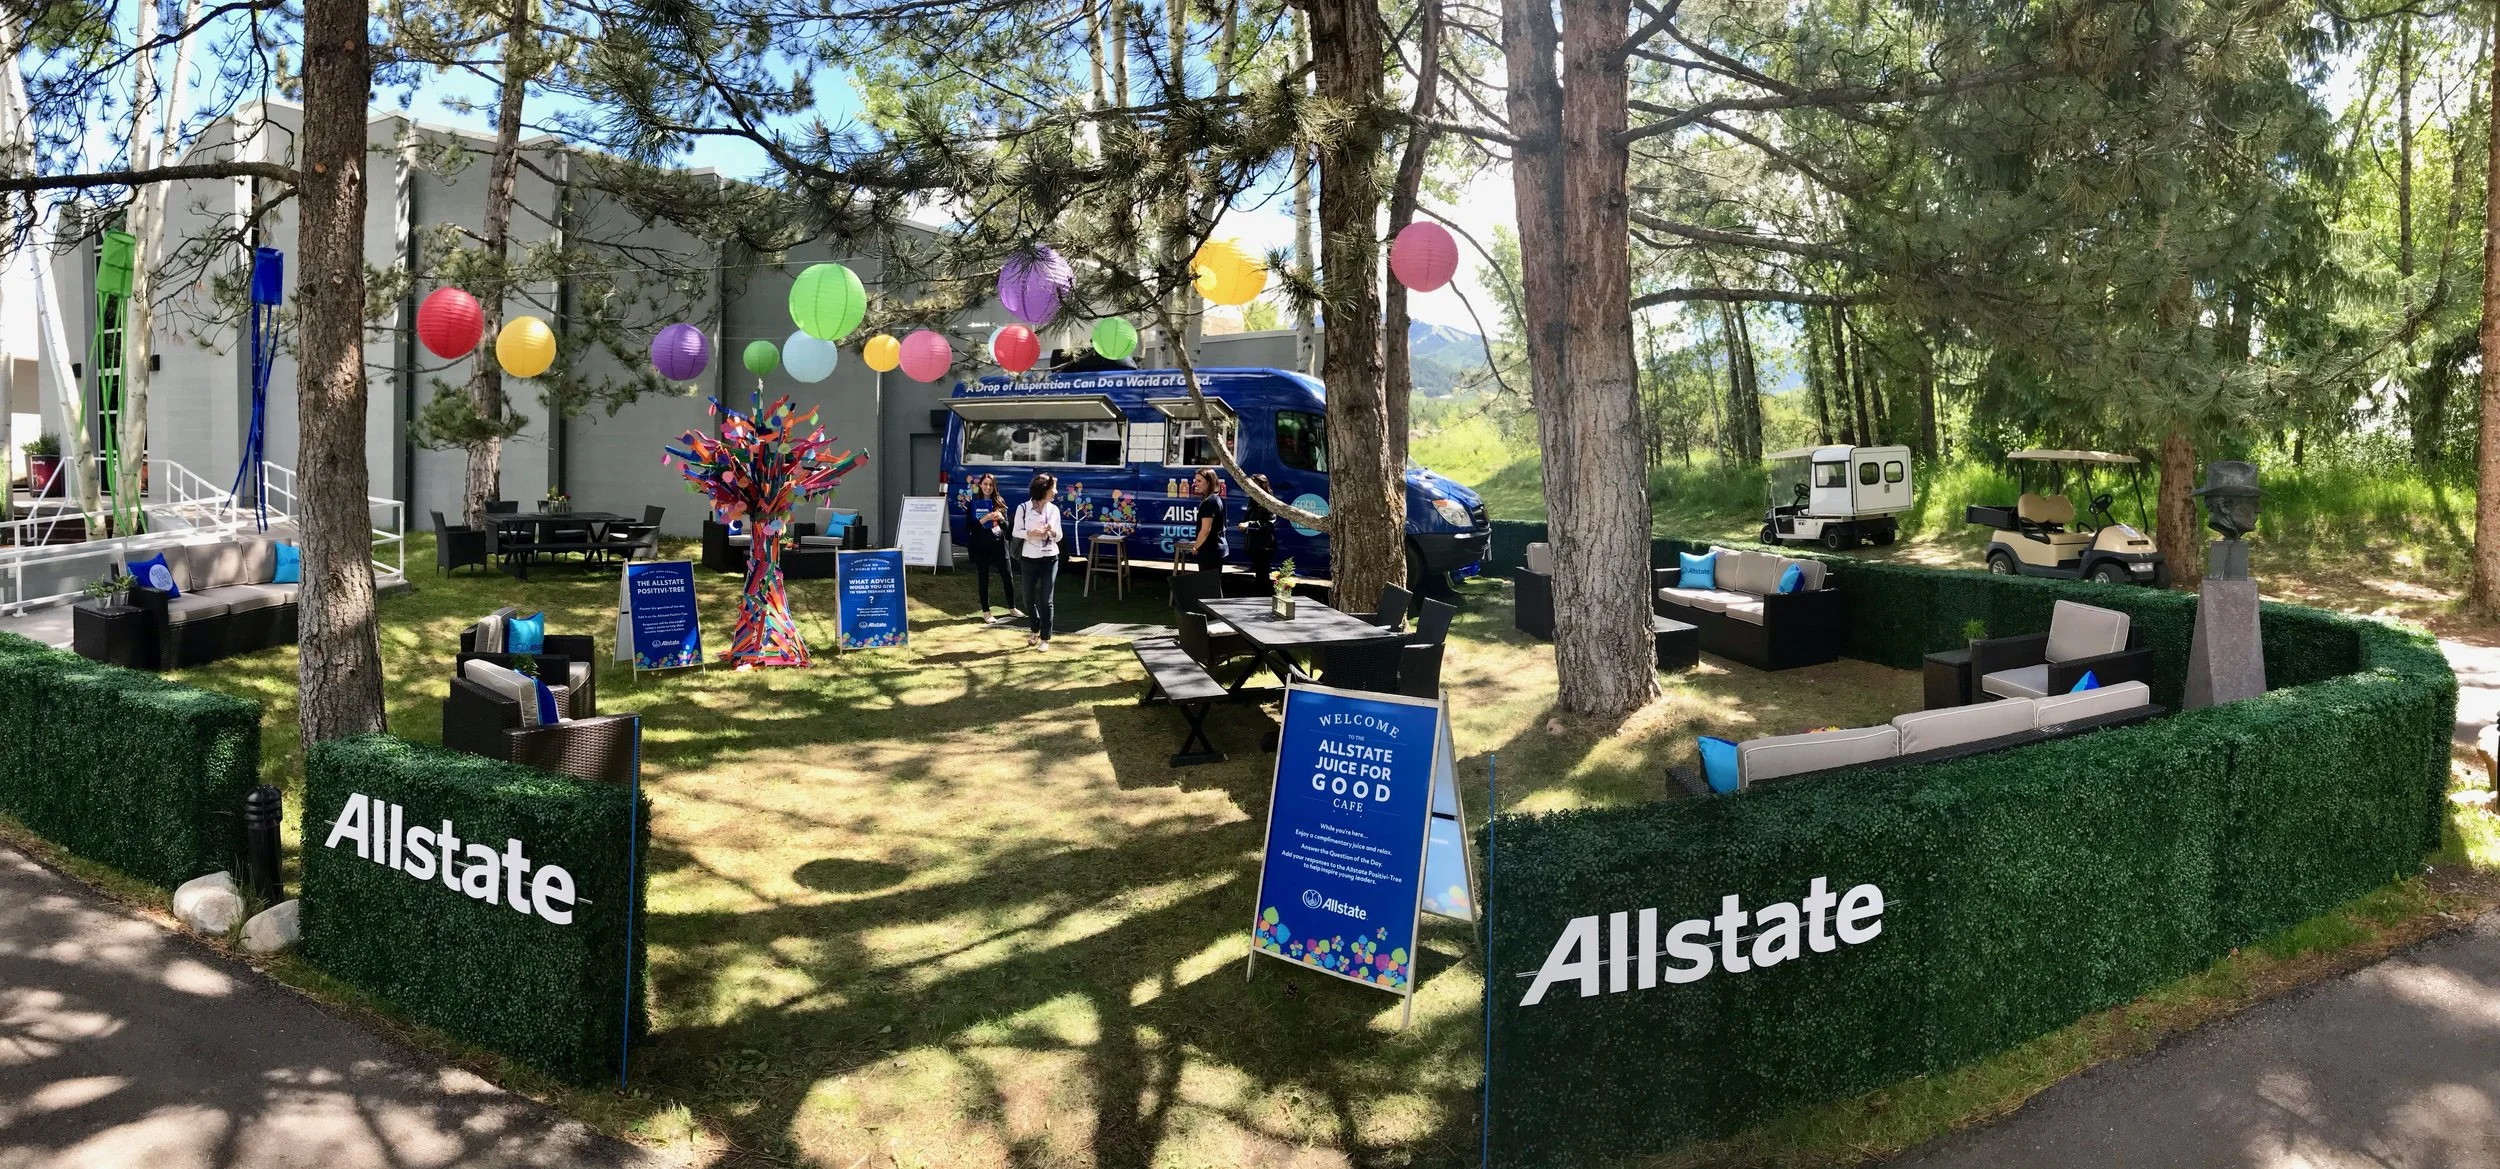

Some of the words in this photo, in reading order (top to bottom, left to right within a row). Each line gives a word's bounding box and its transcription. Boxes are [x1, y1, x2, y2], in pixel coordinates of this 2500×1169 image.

[976, 382, 1000, 394] Drop
[1002, 381, 1014, 391] of
[1014, 380, 1071, 393] Inspiration
[1073, 379, 1095, 389] Can
[1098, 378, 1114, 388] Do
[1126, 375, 1160, 387] World
[1162, 375, 1175, 387] of
[1177, 374, 1213, 386] Gd.
[1163, 506, 1199, 521] Allst
[1161, 526, 1197, 538] JUICE
[638, 587, 685, 595] POSITIVI-TREE
[1319, 713, 1400, 739] WELCOME
[1318, 739, 1393, 763] ALLSTATE
[1315, 756, 1357, 775] JUICE
[1360, 763, 1391, 781] FOR
[1312, 773, 1391, 802] GOOD
[1333, 798, 1363, 812] CAFE
[1320, 822, 1335, 831] While
[1295, 829, 1309, 838] Enjoy
[1314, 834, 1352, 848] complimentary
[1377, 848, 1392, 856] relax.
[324, 792, 576, 926] Allstate
[1301, 843, 1320, 852] Answer
[1329, 850, 1354, 861] Question
[1370, 859, 1383, 868] Day.
[1304, 857, 1329, 866] responses
[1346, 865, 1368, 875] Allstate
[1368, 870, 1402, 883] Positivi-Tree
[1309, 863, 1320, 872] help
[1320, 866, 1338, 875] inspire
[1338, 871, 1354, 881] young
[1355, 874, 1377, 885] leaders.
[1322, 898, 1367, 920] Allstate
[1519, 876, 1884, 1007] Allstate
